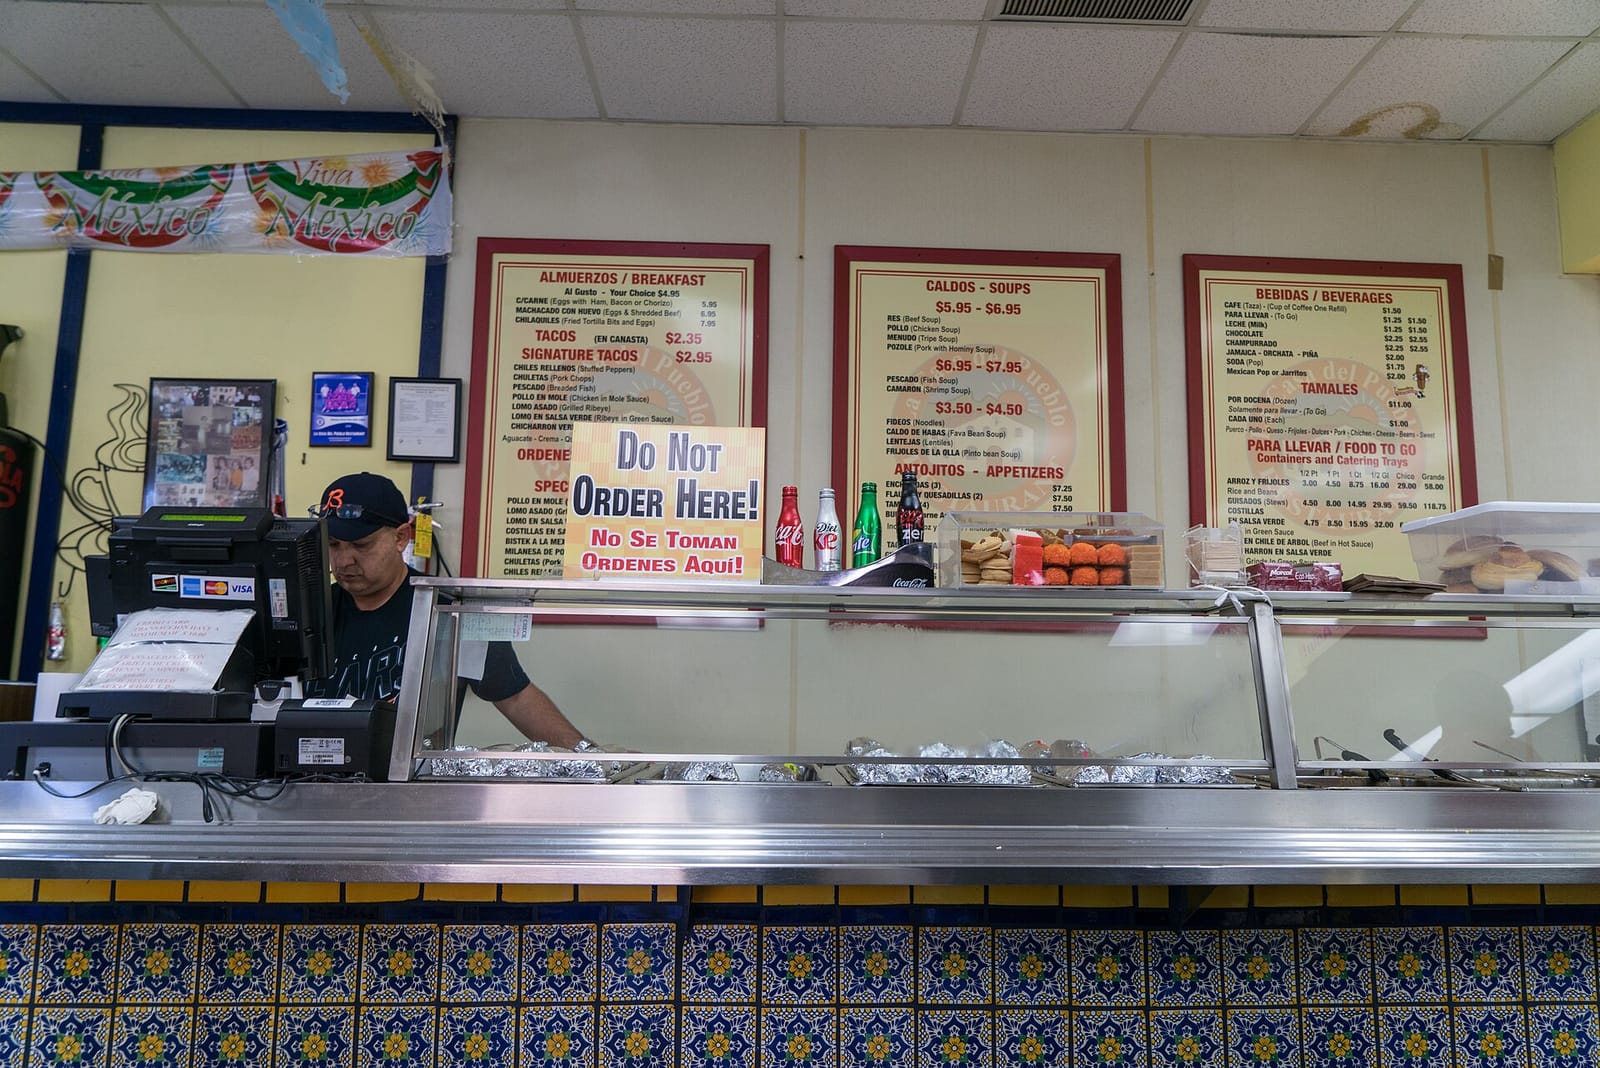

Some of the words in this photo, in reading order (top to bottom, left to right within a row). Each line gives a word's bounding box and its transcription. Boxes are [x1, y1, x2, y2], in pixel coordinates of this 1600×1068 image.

[293, 159, 354, 186] Viva
[257, 191, 418, 252] México
[540, 272, 618, 284] ALMUERZOS
[632, 273, 706, 286] BREAKFAST
[927, 280, 975, 292] CALDOS
[990, 282, 1031, 294] SOUPS
[564, 288, 572, 296] Al
[575, 288, 598, 296] Gusto
[658, 290, 680, 298] $4.95
[1256, 288, 1308, 301] BEBIDAS
[1322, 291, 1392, 304] BEVERAGES
[936, 301, 972, 314] $5.95
[986, 303, 1021, 315] $6.95
[1242, 302, 1262, 310] (Taza)
[1329, 305, 1347, 313] Refill)
[941, 326, 960, 334] Soup)
[536, 330, 576, 342] TACOS
[665, 332, 702, 345] $2.35
[887, 334, 917, 342] MENUDO
[939, 336, 958, 344] Soup)
[976, 346, 995, 354] Soup)
[522, 348, 594, 361] SIGNATURE
[597, 350, 638, 362] TACOS
[676, 351, 712, 363] $2.95
[936, 359, 972, 372] $6.95
[986, 360, 1022, 373] $7.95
[1246, 359, 1263, 367] (Pop)
[514, 364, 538, 372] CHILES
[540, 364, 576, 372] RELLENOS
[1227, 368, 1255, 376] Mexican
[513, 374, 548, 382] CHULETAS
[923, 386, 949, 394] (Shrimp
[1302, 383, 1359, 395] TAMALES
[548, 394, 568, 402] MOLE
[569, 394, 599, 403] (Chicken
[626, 396, 650, 404] Sauce)
[1272, 397, 1297, 405] (Dozen)
[936, 402, 972, 415] $3.50
[986, 403, 1023, 415] $4.50
[1315, 408, 1326, 416] Go)
[544, 414, 568, 422] SALSA
[570, 414, 592, 422] VERDE
[594, 415, 618, 424] (Ribeye
[502, 435, 532, 443] Aguacate
[886, 438, 920, 446] LENTEJAS
[1247, 440, 1281, 452] PARA
[1285, 441, 1330, 453] LLEVAR
[1345, 442, 1376, 455] FOOD
[1382, 443, 1395, 455] TO
[1401, 444, 1416, 456] GO
[1257, 454, 1314, 465] Containers
[1315, 455, 1334, 465] and
[1337, 455, 1380, 467] Catering
[1382, 457, 1408, 468] Trays
[894, 463, 965, 476] ANTOJITOS
[987, 466, 1064, 479] APPETIZERS
[1258, 478, 1290, 486] FRIJOLES
[1228, 507, 1264, 515] COSTILLAS
[540, 518, 564, 526] SALSA
[506, 527, 544, 535] COSTILLAS
[817, 522, 838, 533] Diet
[1253, 528, 1272, 536] Green
[1288, 538, 1310, 546] ARBOL
[504, 548, 542, 556] MILANESA
[544, 548, 554, 556] DE
[504, 558, 540, 566] CHULETAS
[542, 558, 561, 566] (Pork
[504, 568, 528, 576] CHILES
[232, 584, 253, 593] VISA
